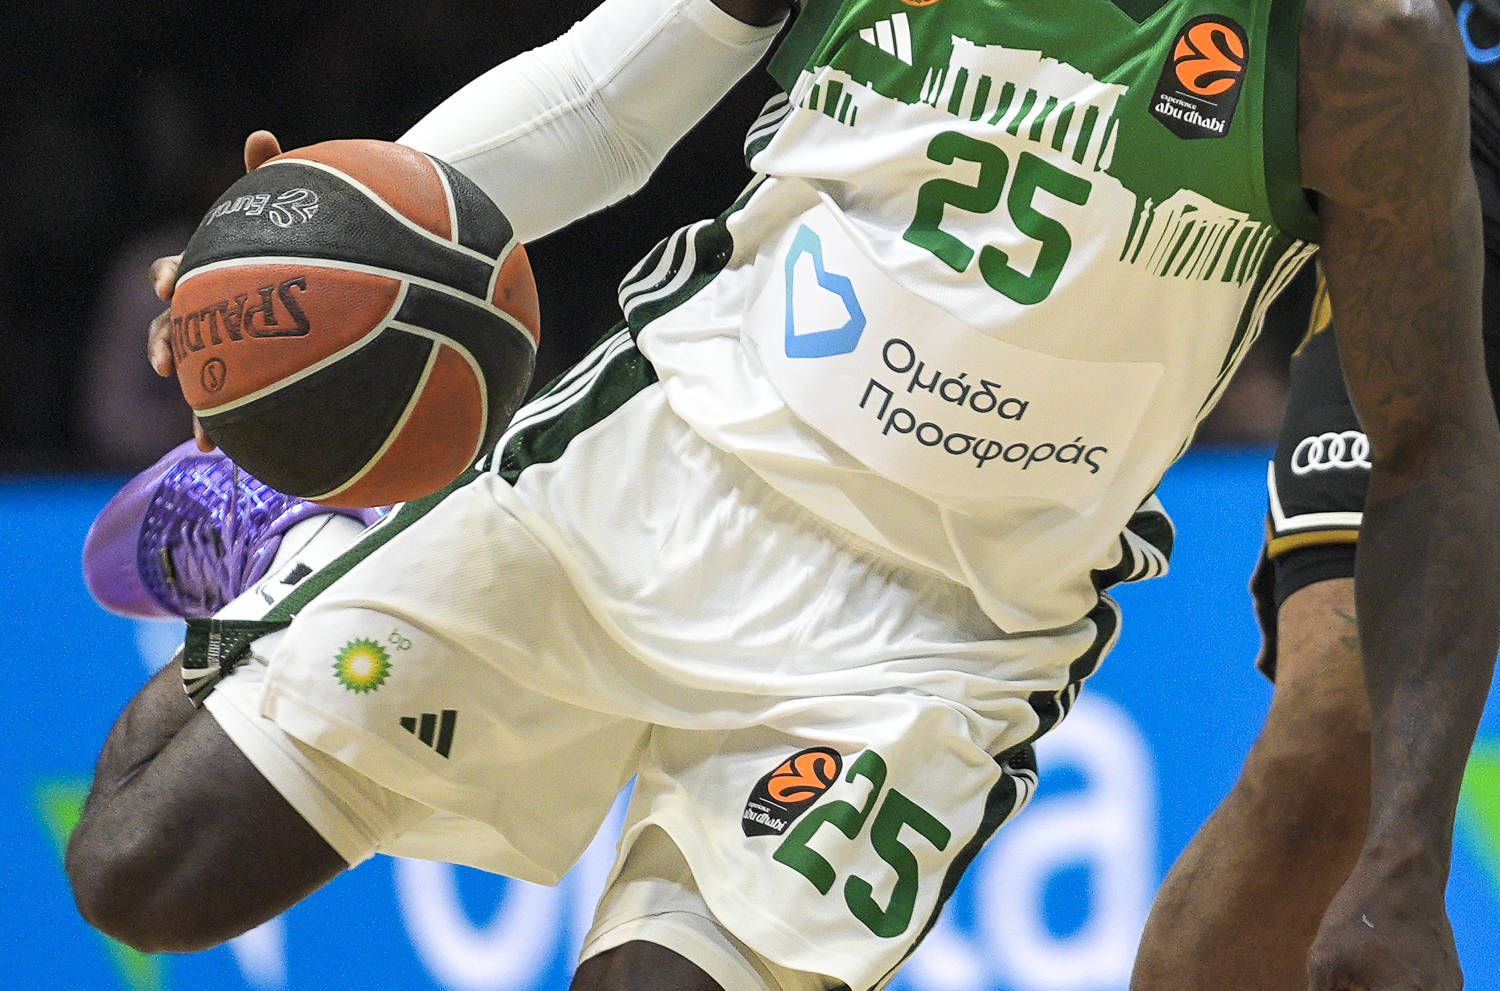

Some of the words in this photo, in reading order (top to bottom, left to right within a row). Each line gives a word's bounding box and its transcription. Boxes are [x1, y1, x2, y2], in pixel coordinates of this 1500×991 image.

[1154, 102, 1183, 120] abu
[1183, 110, 1226, 133] dhabi
[1160, 93, 1198, 110] experience
[902, 130, 1093, 306] 25
[882, 338, 1030, 421] Ομάδα
[859, 378, 1109, 474] Προσφοράς
[387, 628, 411, 651] bp
[756, 813, 788, 832] dhabi
[772, 749, 952, 938] 25
